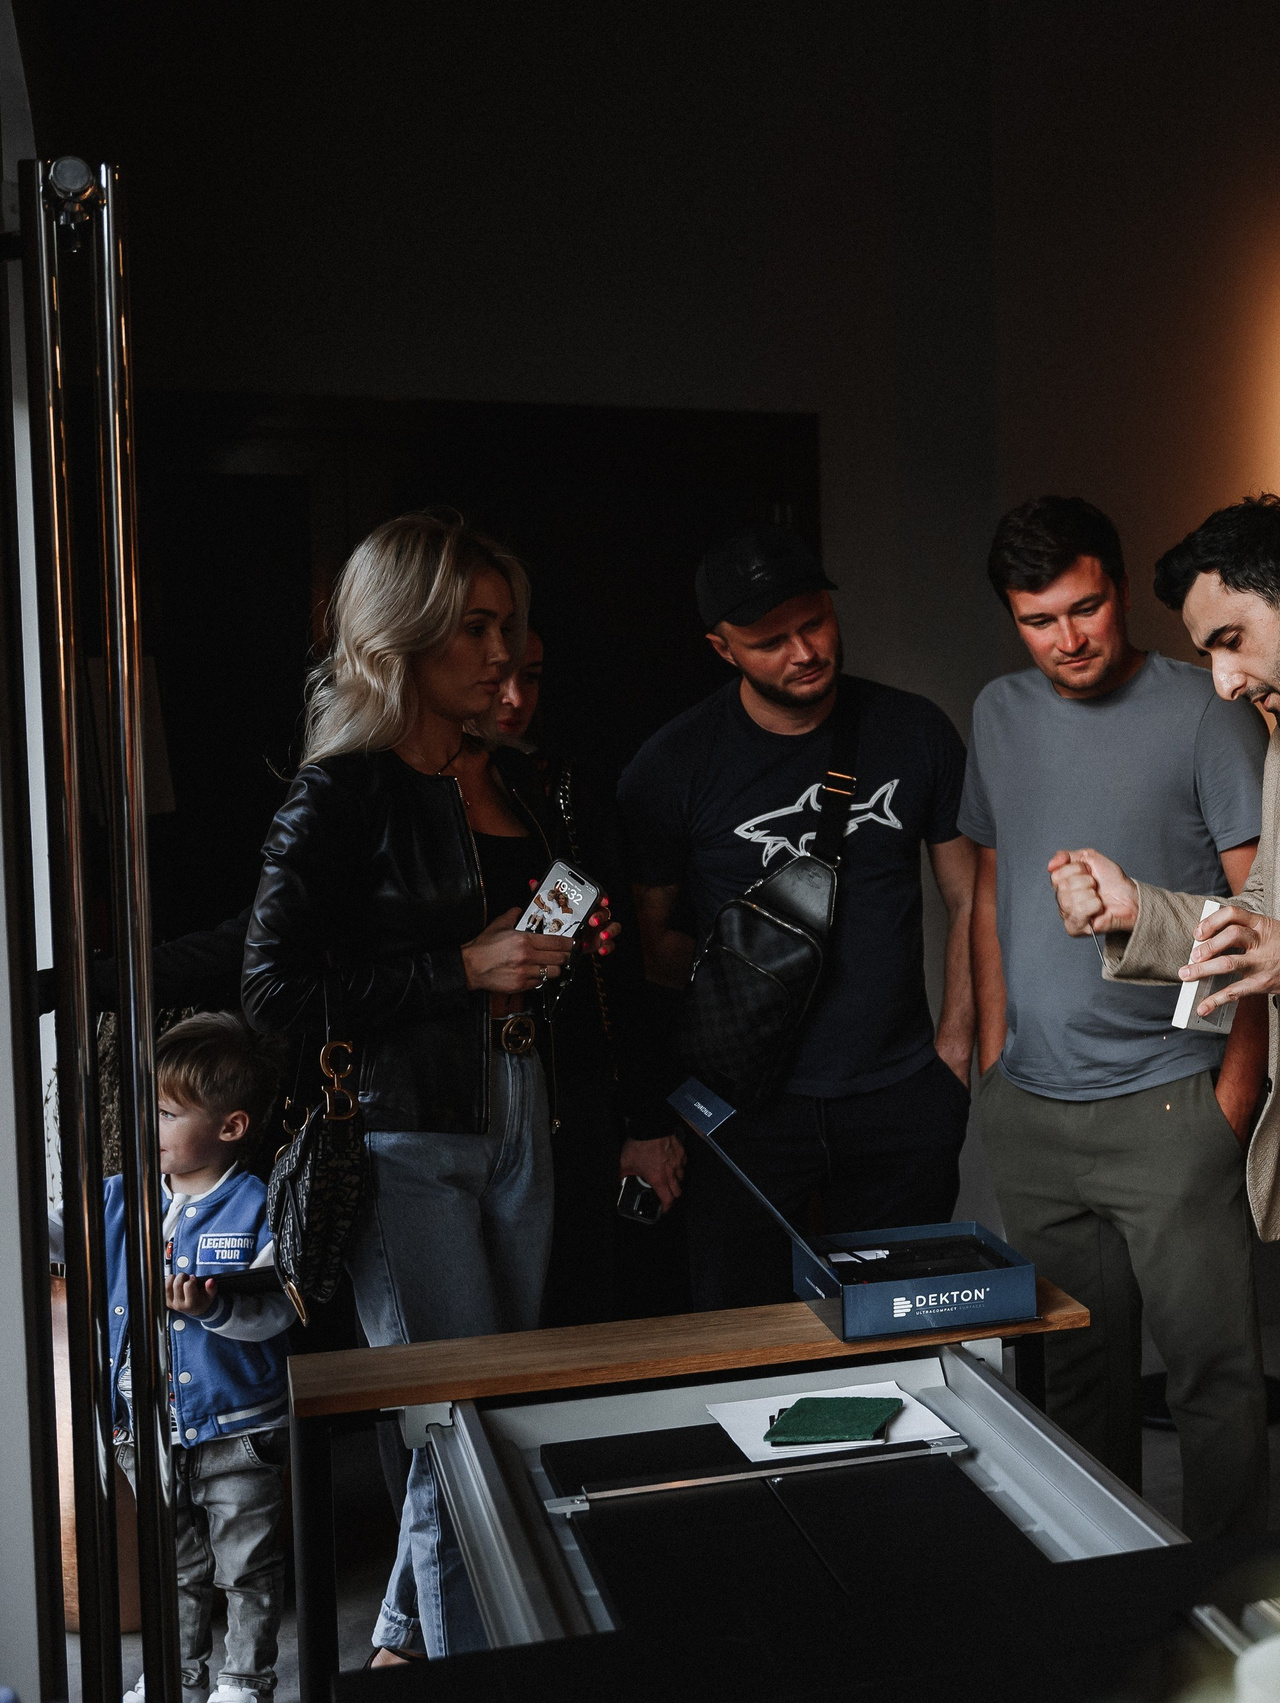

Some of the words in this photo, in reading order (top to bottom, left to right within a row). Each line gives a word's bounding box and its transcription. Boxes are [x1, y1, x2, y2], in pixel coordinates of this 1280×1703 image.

[555, 878, 583, 906] 19:32
[201, 1237, 255, 1249] LEGENDARY
[214, 1249, 241, 1260] TOUR
[915, 1307, 958, 1315] ULTRACOMPACT
